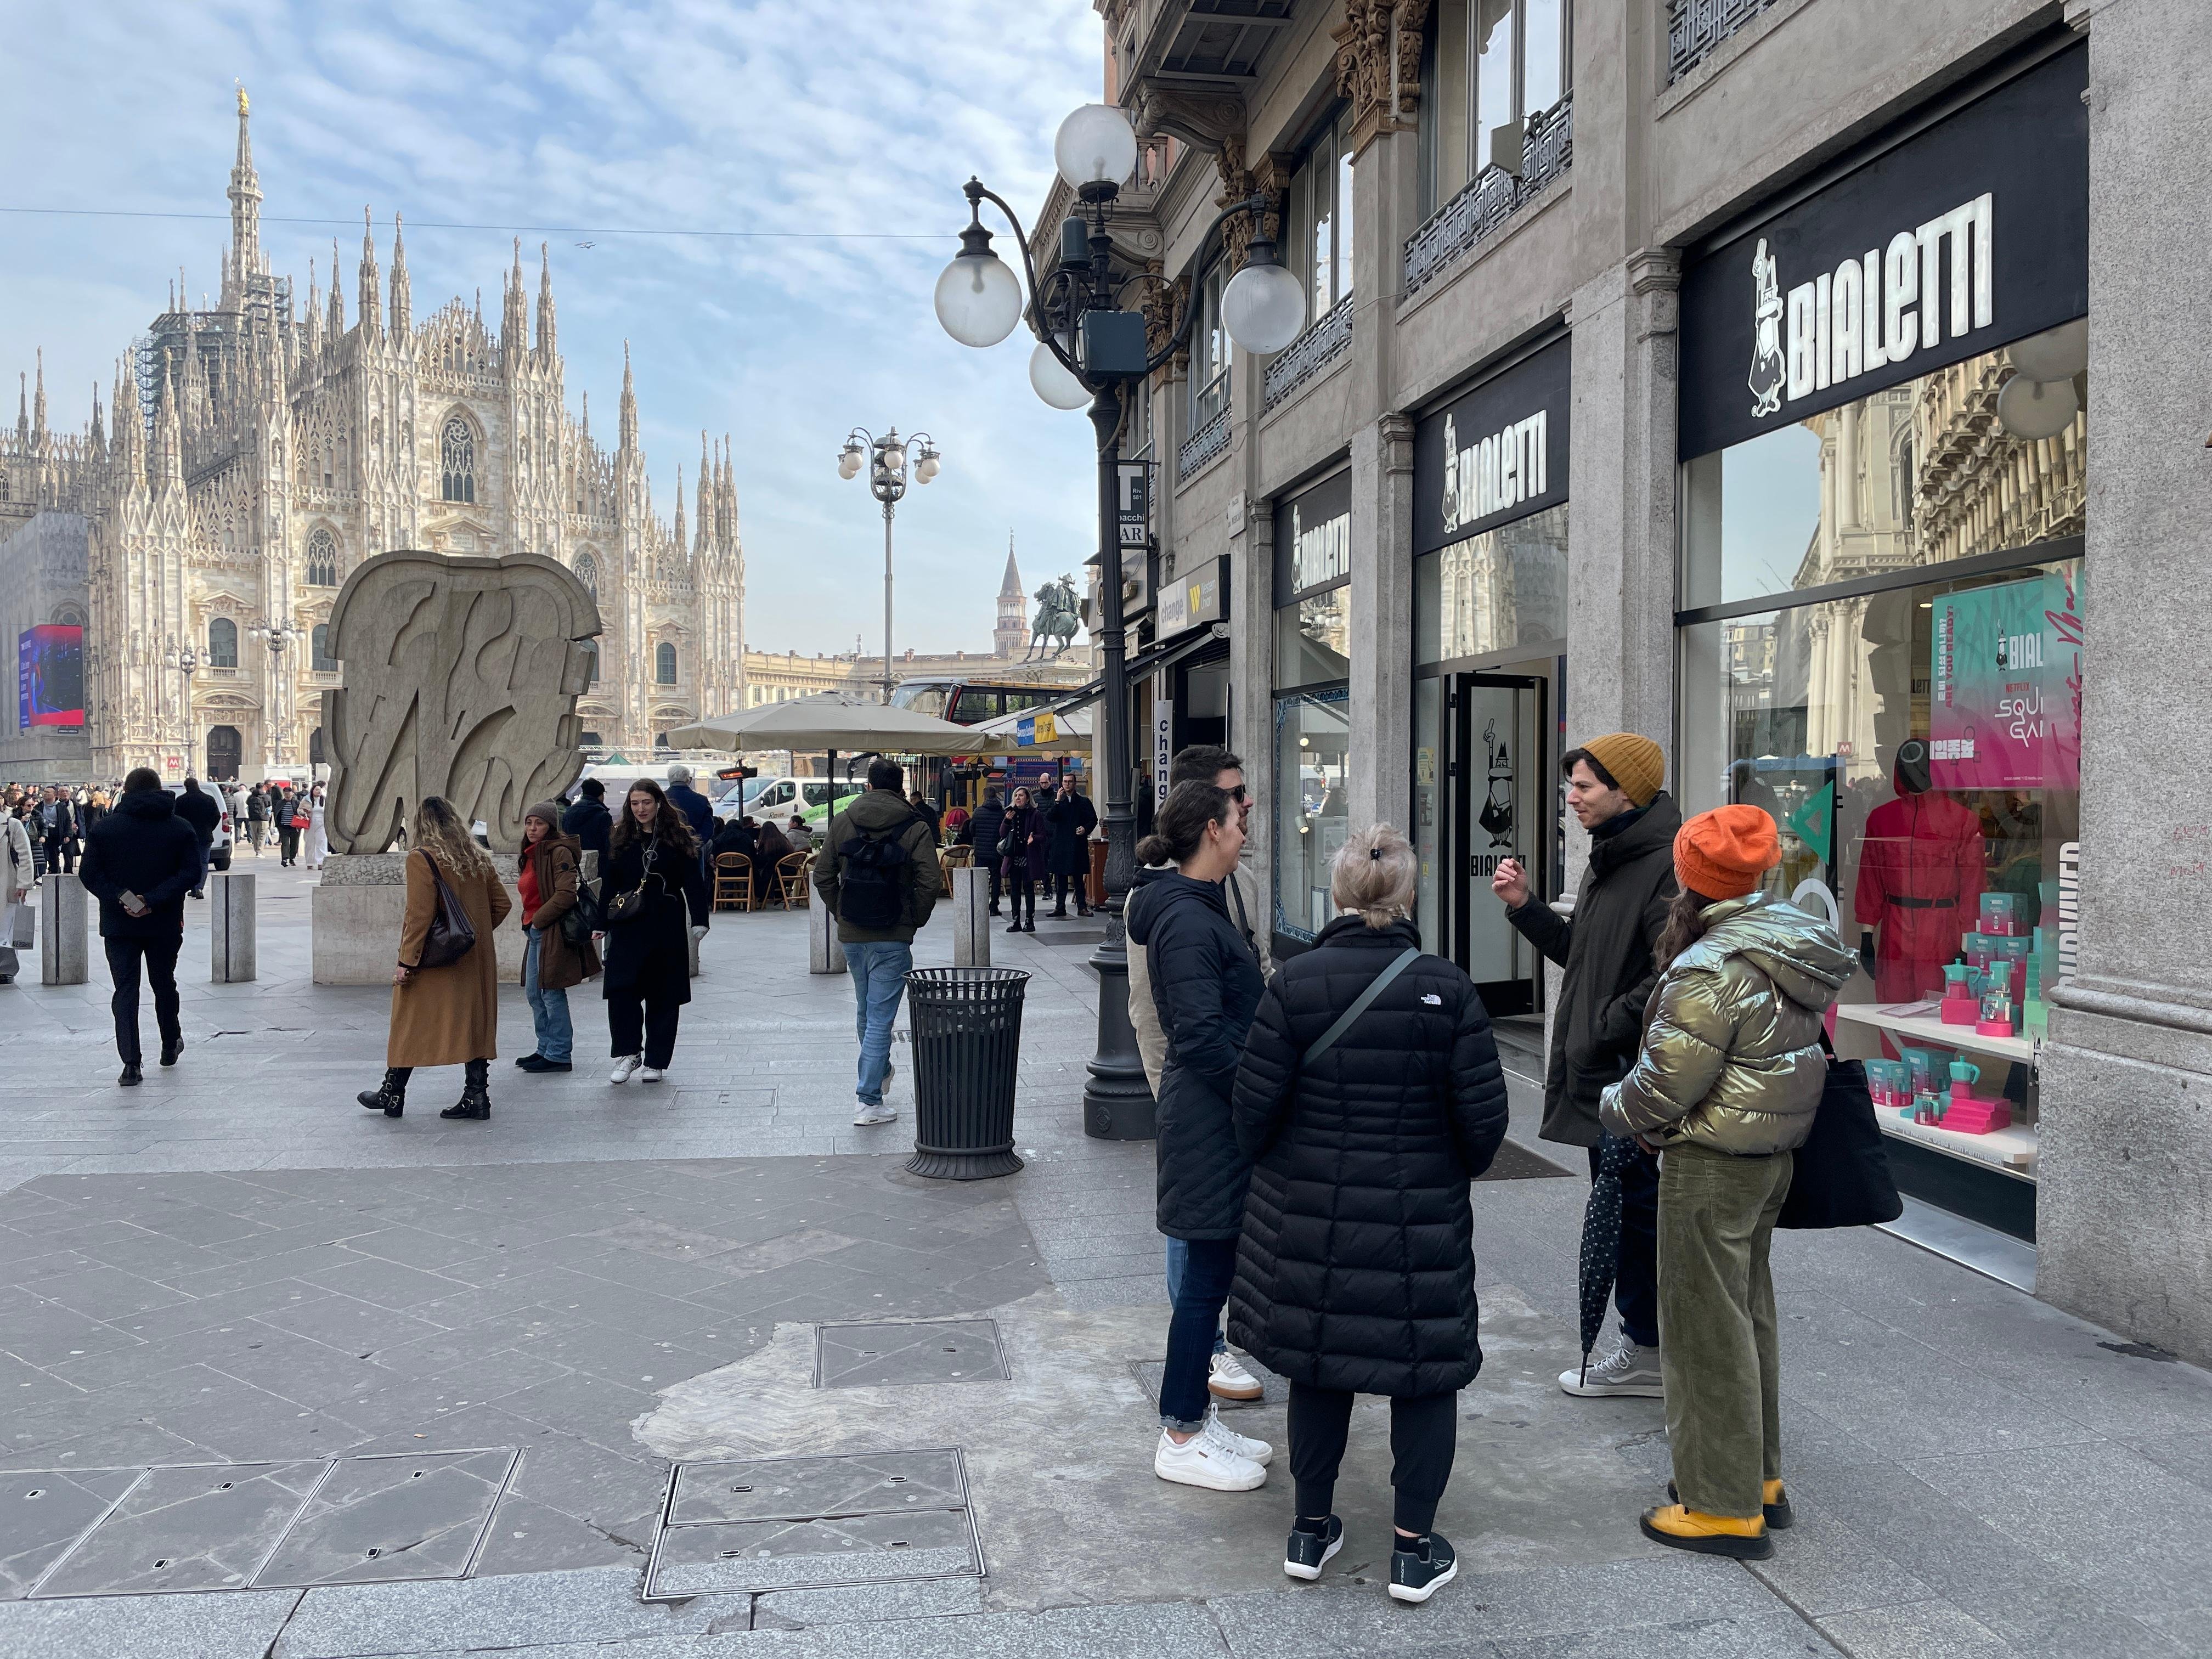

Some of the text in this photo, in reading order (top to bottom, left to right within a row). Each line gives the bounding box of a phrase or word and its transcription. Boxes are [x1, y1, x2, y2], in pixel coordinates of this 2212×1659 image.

[1161, 598, 1183, 623] change
[2006, 682, 2029, 693] NETFLIX
[1950, 1142, 1963, 1153] with
